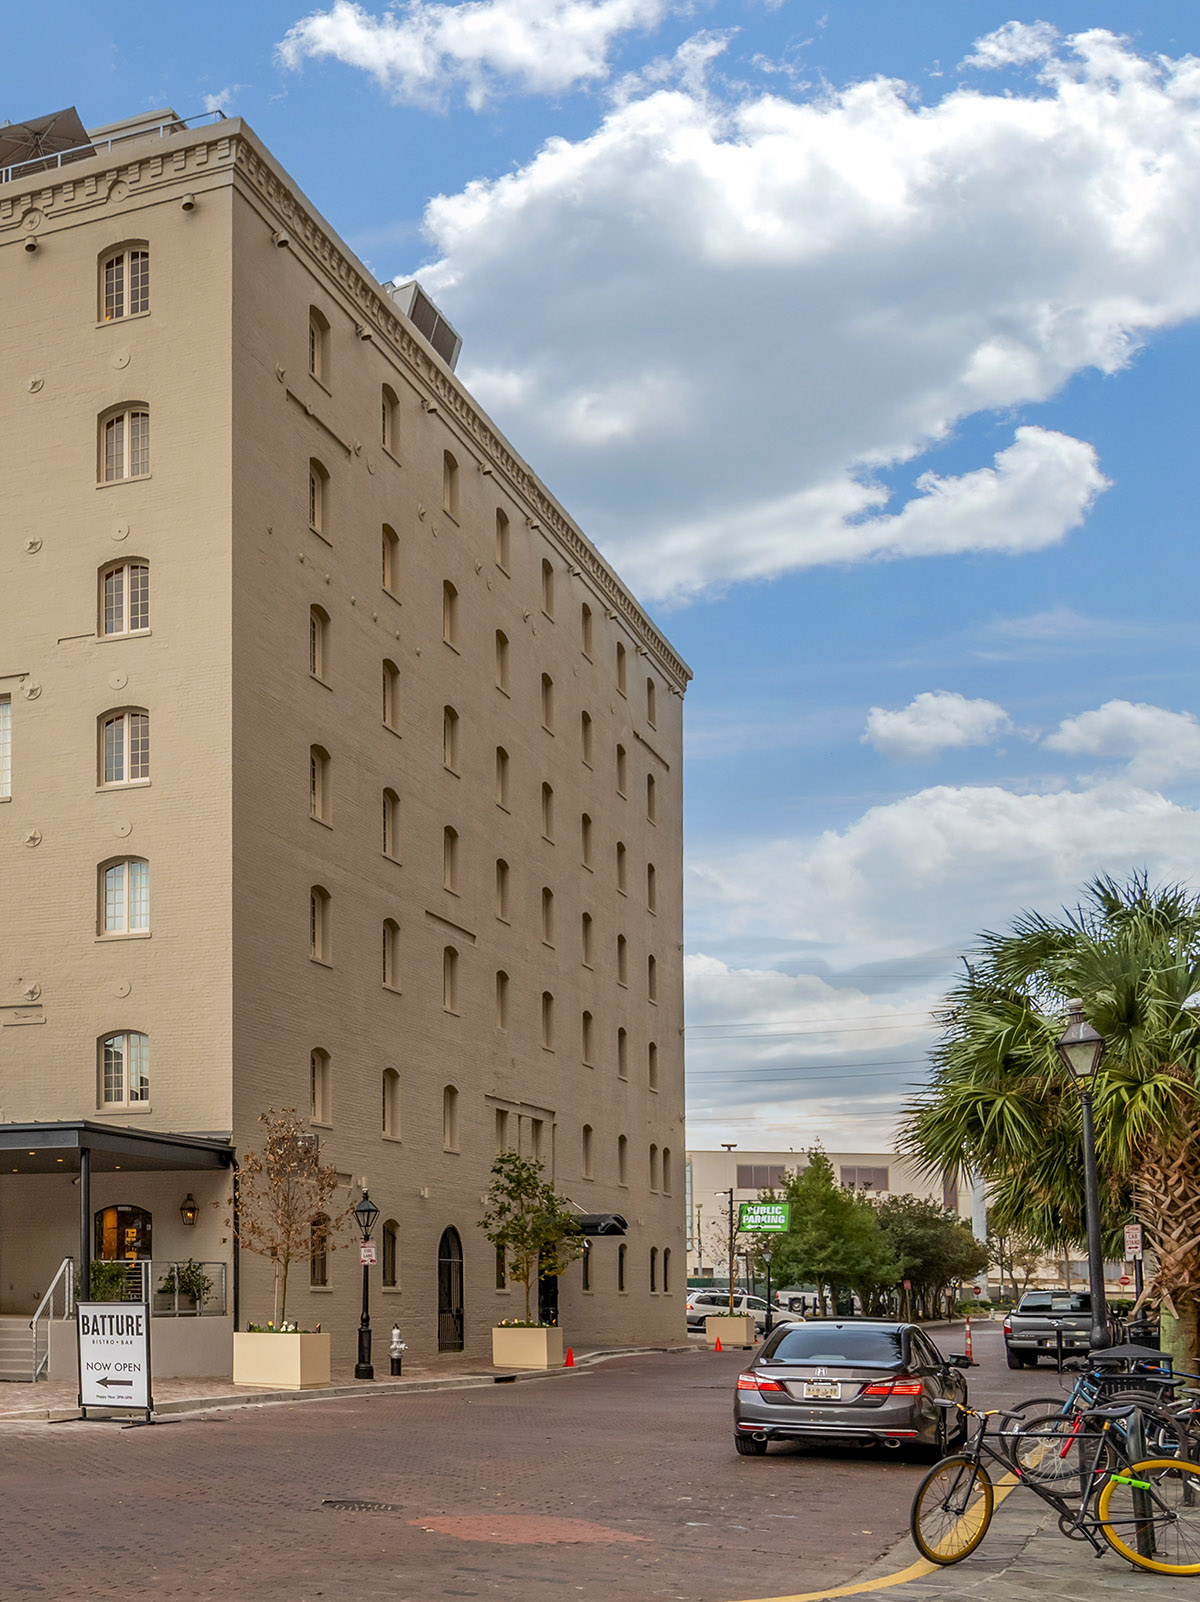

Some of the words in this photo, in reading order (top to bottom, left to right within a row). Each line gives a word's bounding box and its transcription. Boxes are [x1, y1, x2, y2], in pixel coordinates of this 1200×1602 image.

[747, 1206, 782, 1215] PUBLIC
[743, 1215, 785, 1224] PARKING
[81, 1314, 143, 1336] BATTURE
[86, 1362, 112, 1371] NOW
[114, 1362, 141, 1372] OPEN
